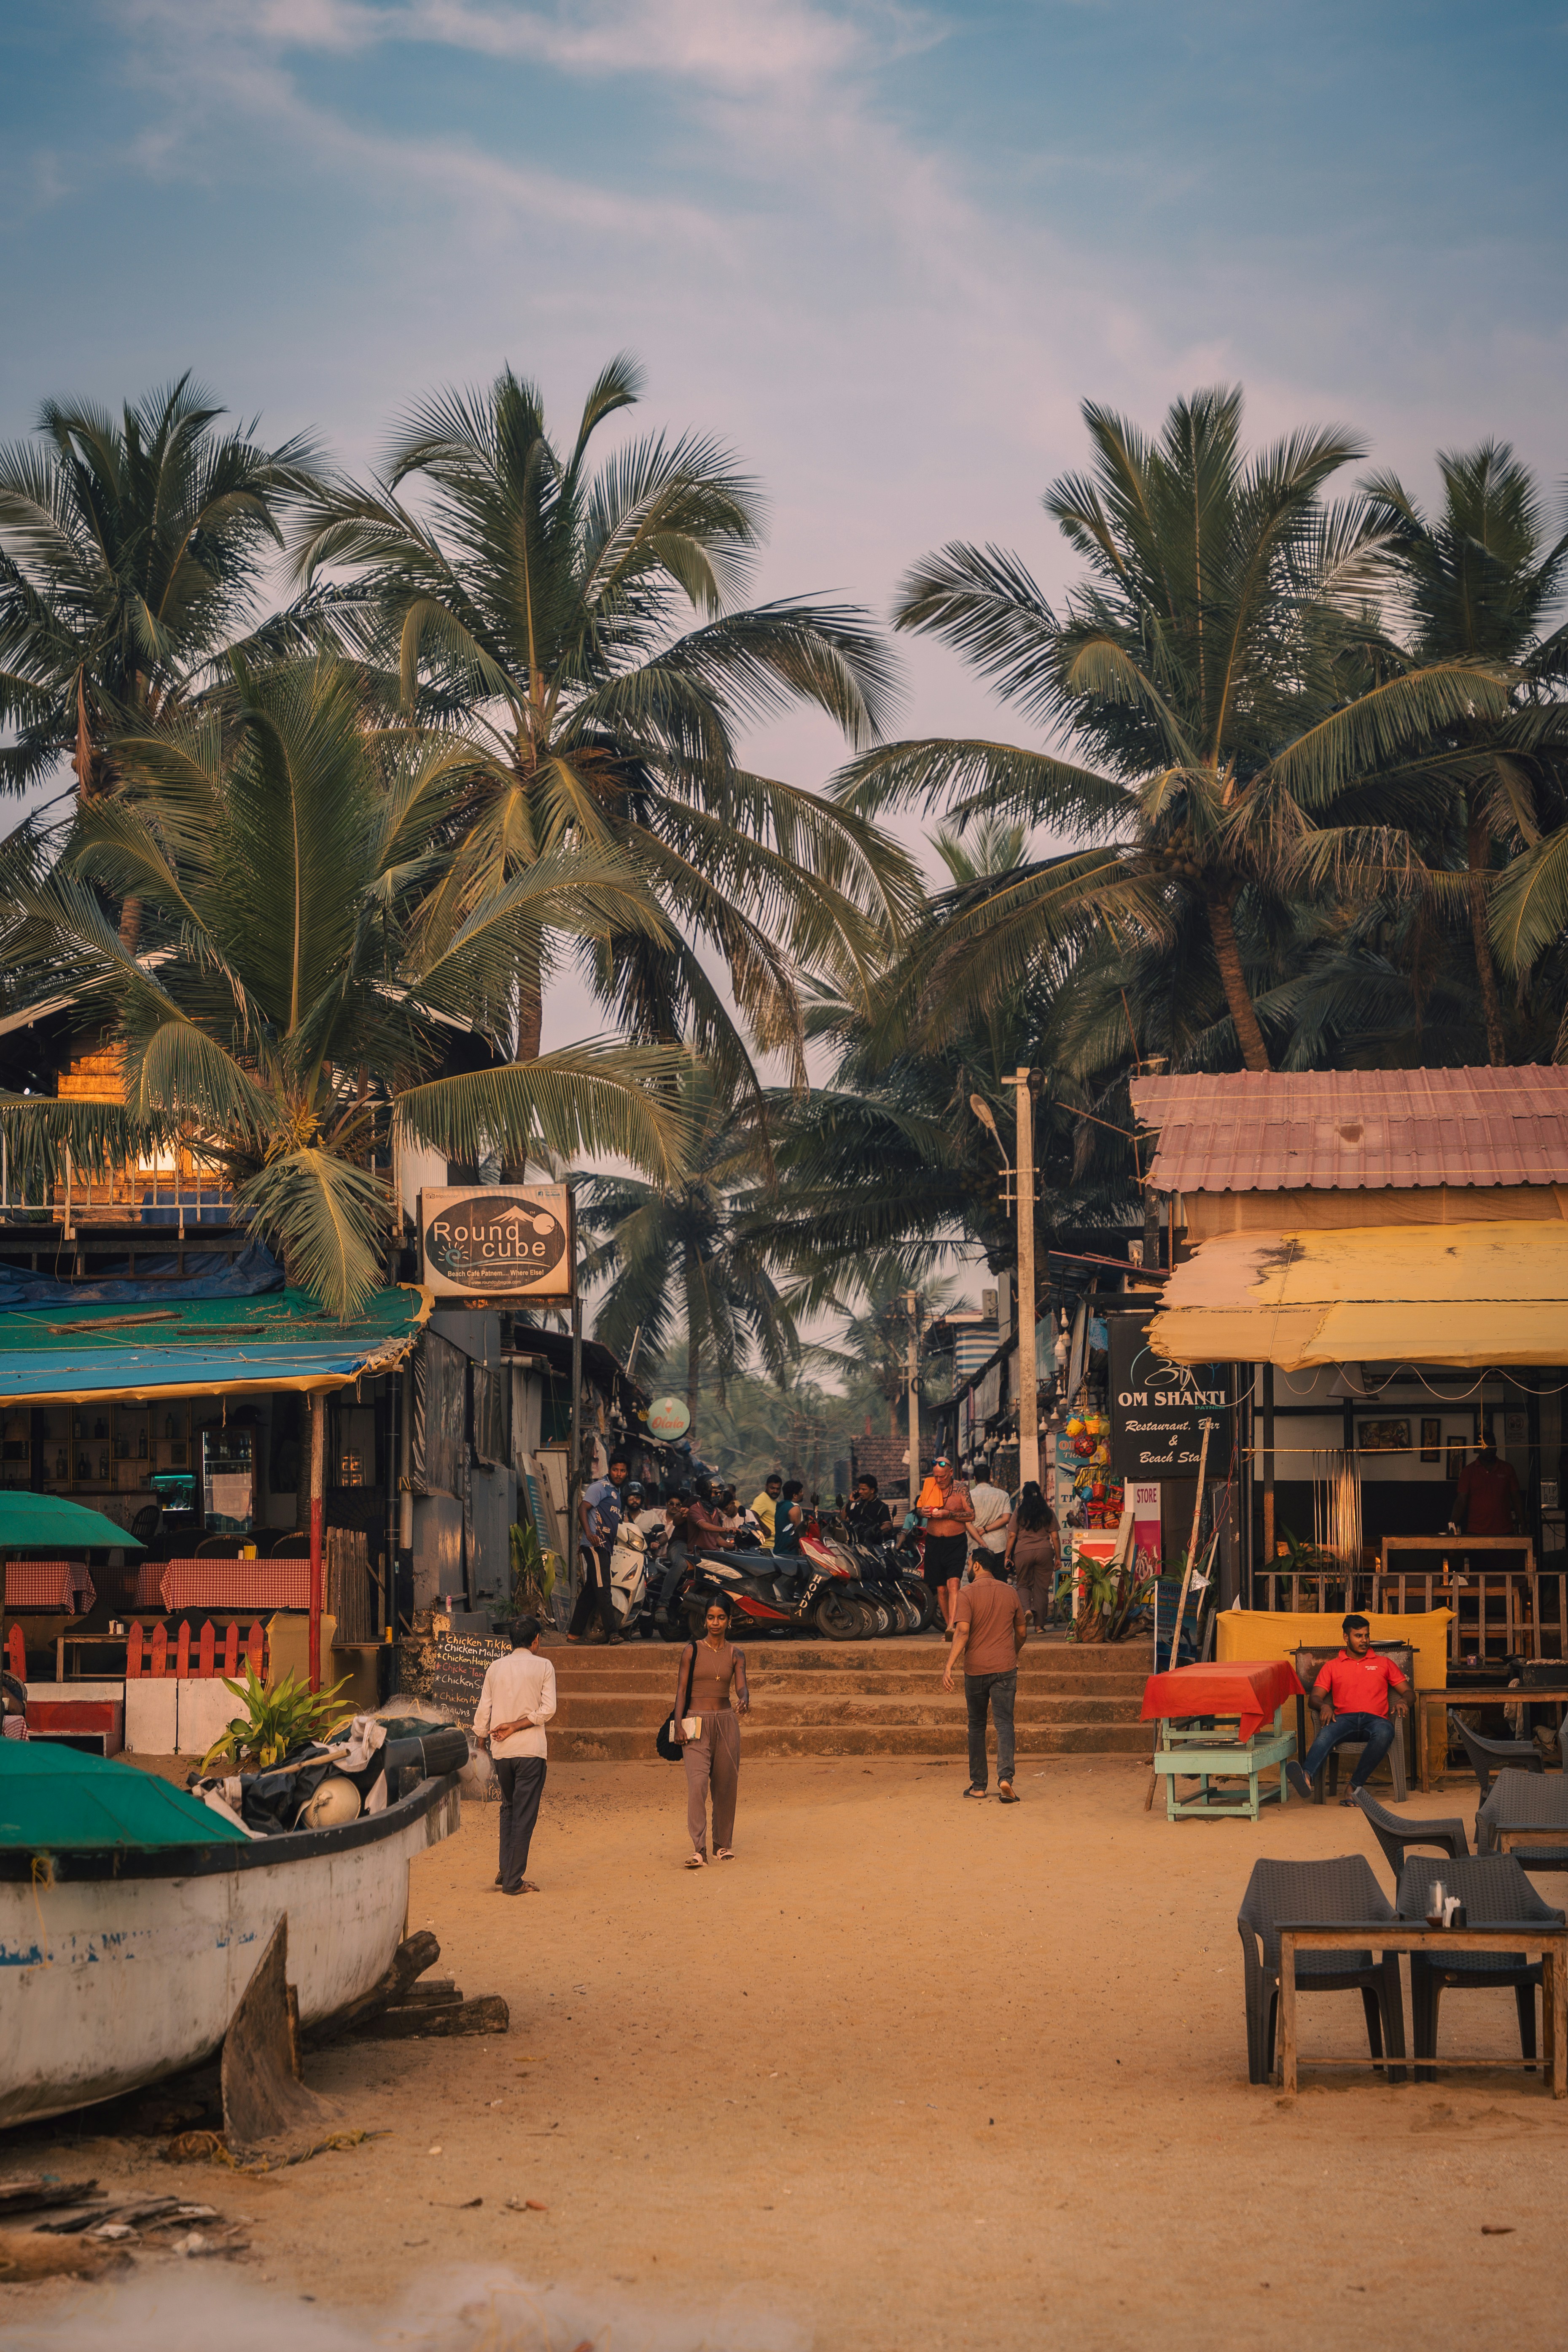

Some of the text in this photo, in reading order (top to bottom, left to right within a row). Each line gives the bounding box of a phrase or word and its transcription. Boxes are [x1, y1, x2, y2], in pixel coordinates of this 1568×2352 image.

[434, 1221, 519, 1241] Round
[482, 1240, 546, 1257] cube
[1118, 1391, 1225, 1406] OM SHANTI
[651, 1416, 685, 1429] Olala
[1125, 1420, 1191, 1432] Restaurant,
[1169, 1434, 1178, 1446] &
[1140, 1451, 1173, 1463] Beach
[1137, 1488, 1157, 1503] STORE
[1542, 1486, 1557, 1494] TIP
[794, 1574, 822, 1617] HONDA
[446, 1636, 482, 1647] Chicken
[444, 1644, 477, 1655] Chicken
[442, 1652, 472, 1665] Chicken
[441, 1674, 473, 1689] Chicken
[440, 1691, 468, 1704] Chicken
